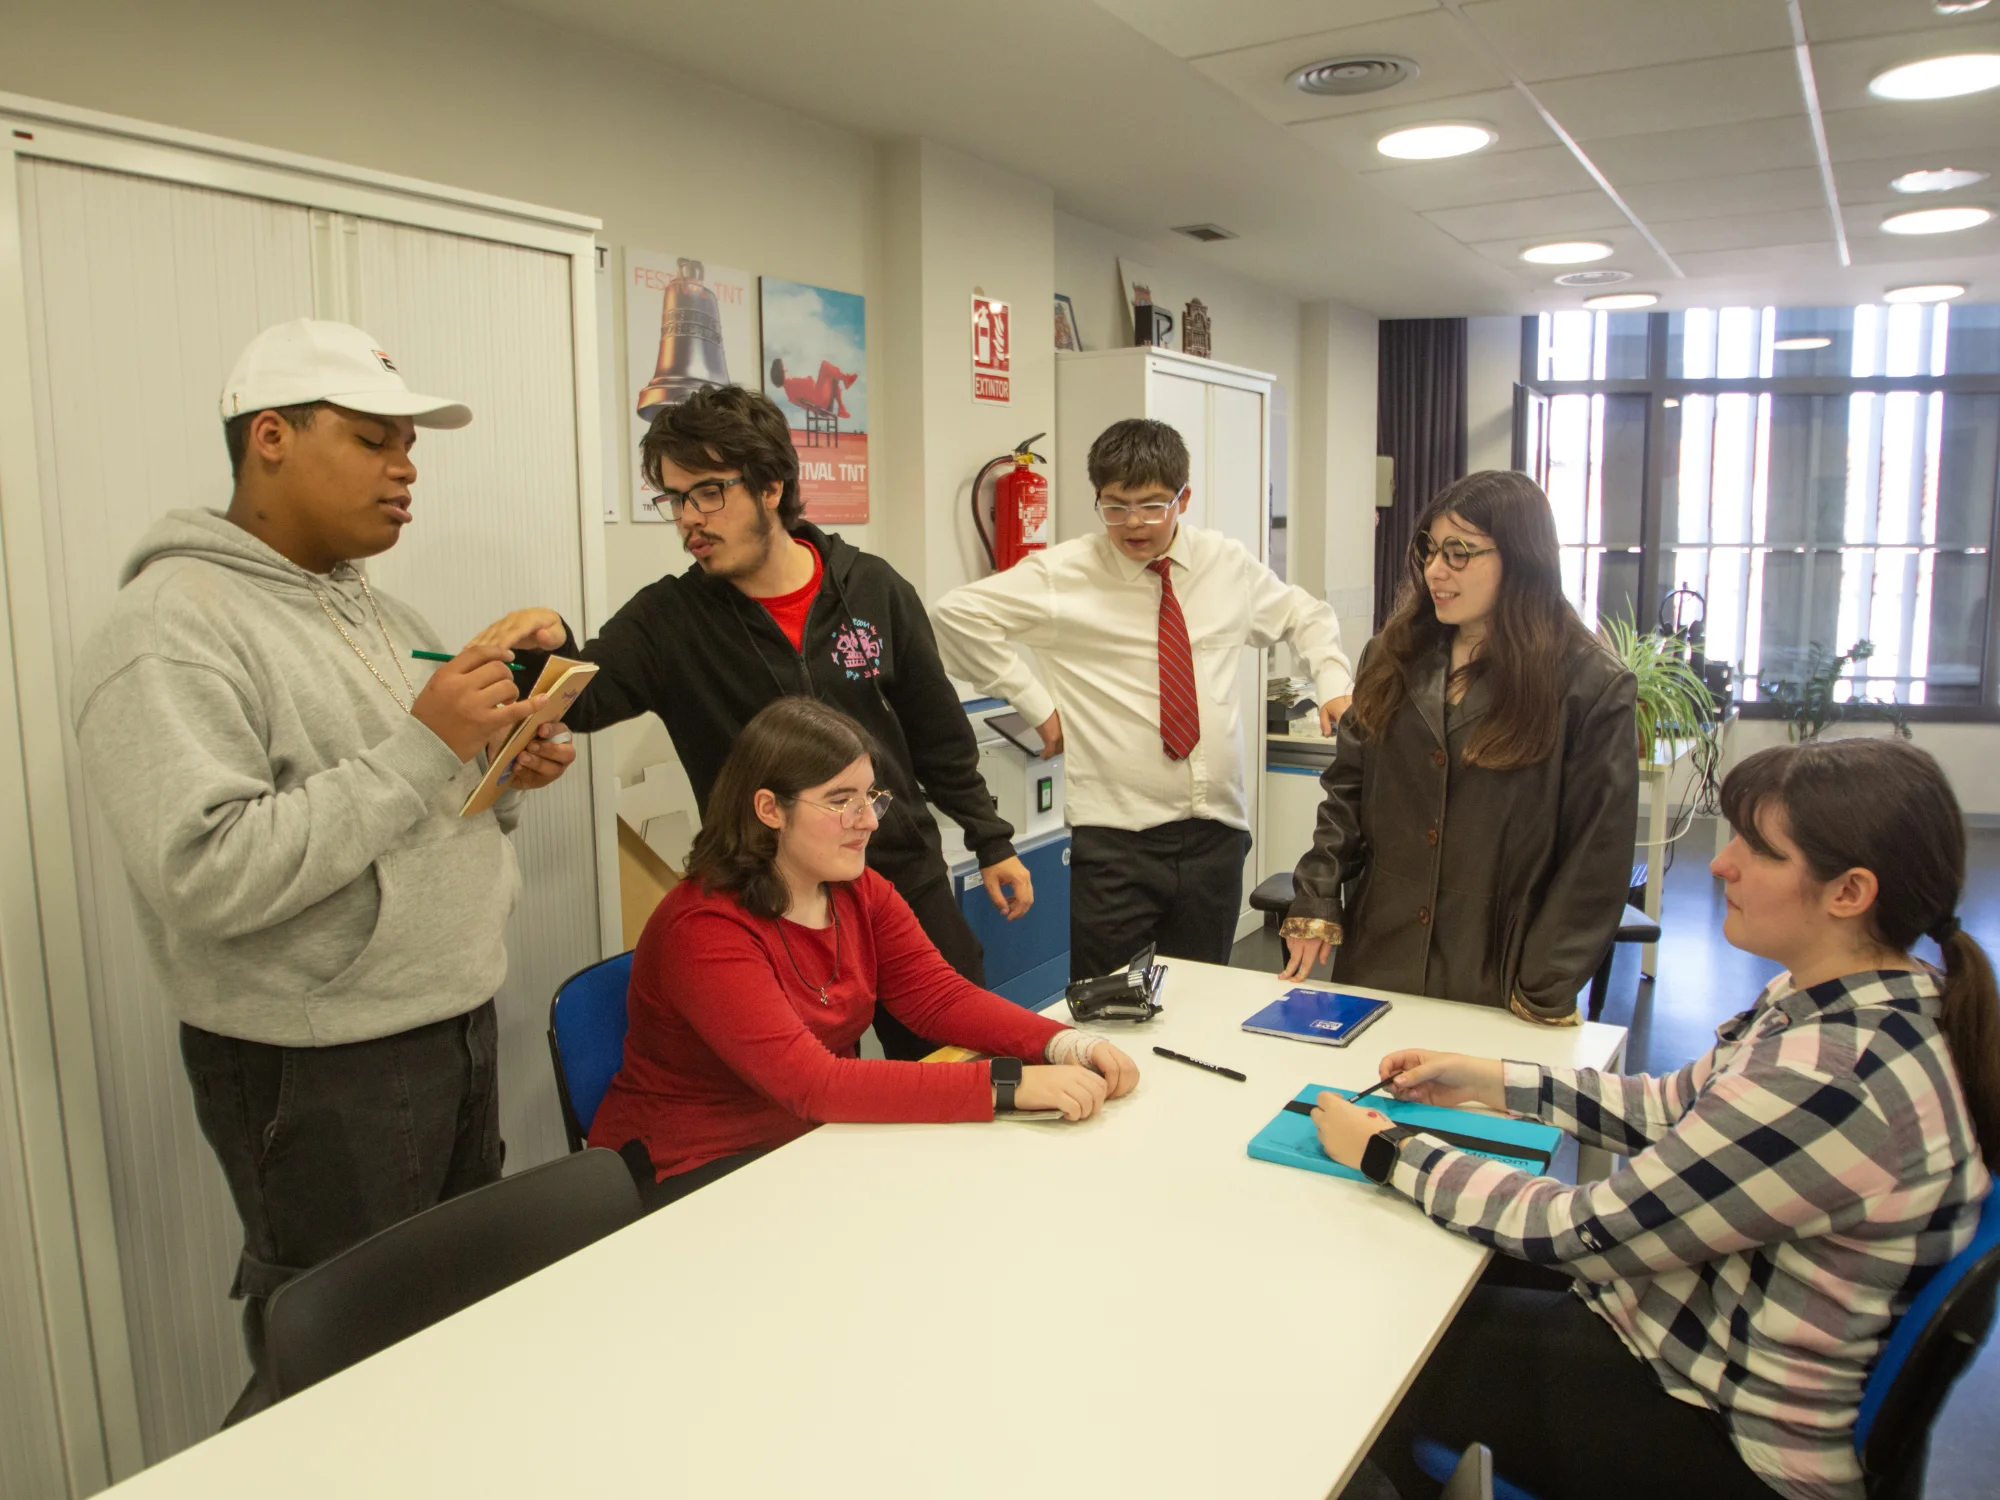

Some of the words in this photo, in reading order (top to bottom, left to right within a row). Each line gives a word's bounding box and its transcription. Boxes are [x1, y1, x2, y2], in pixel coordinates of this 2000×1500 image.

[713, 281, 745, 306] TNT
[975, 376, 1009, 398] EXTINTOR
[838, 463, 867, 482] TNT
